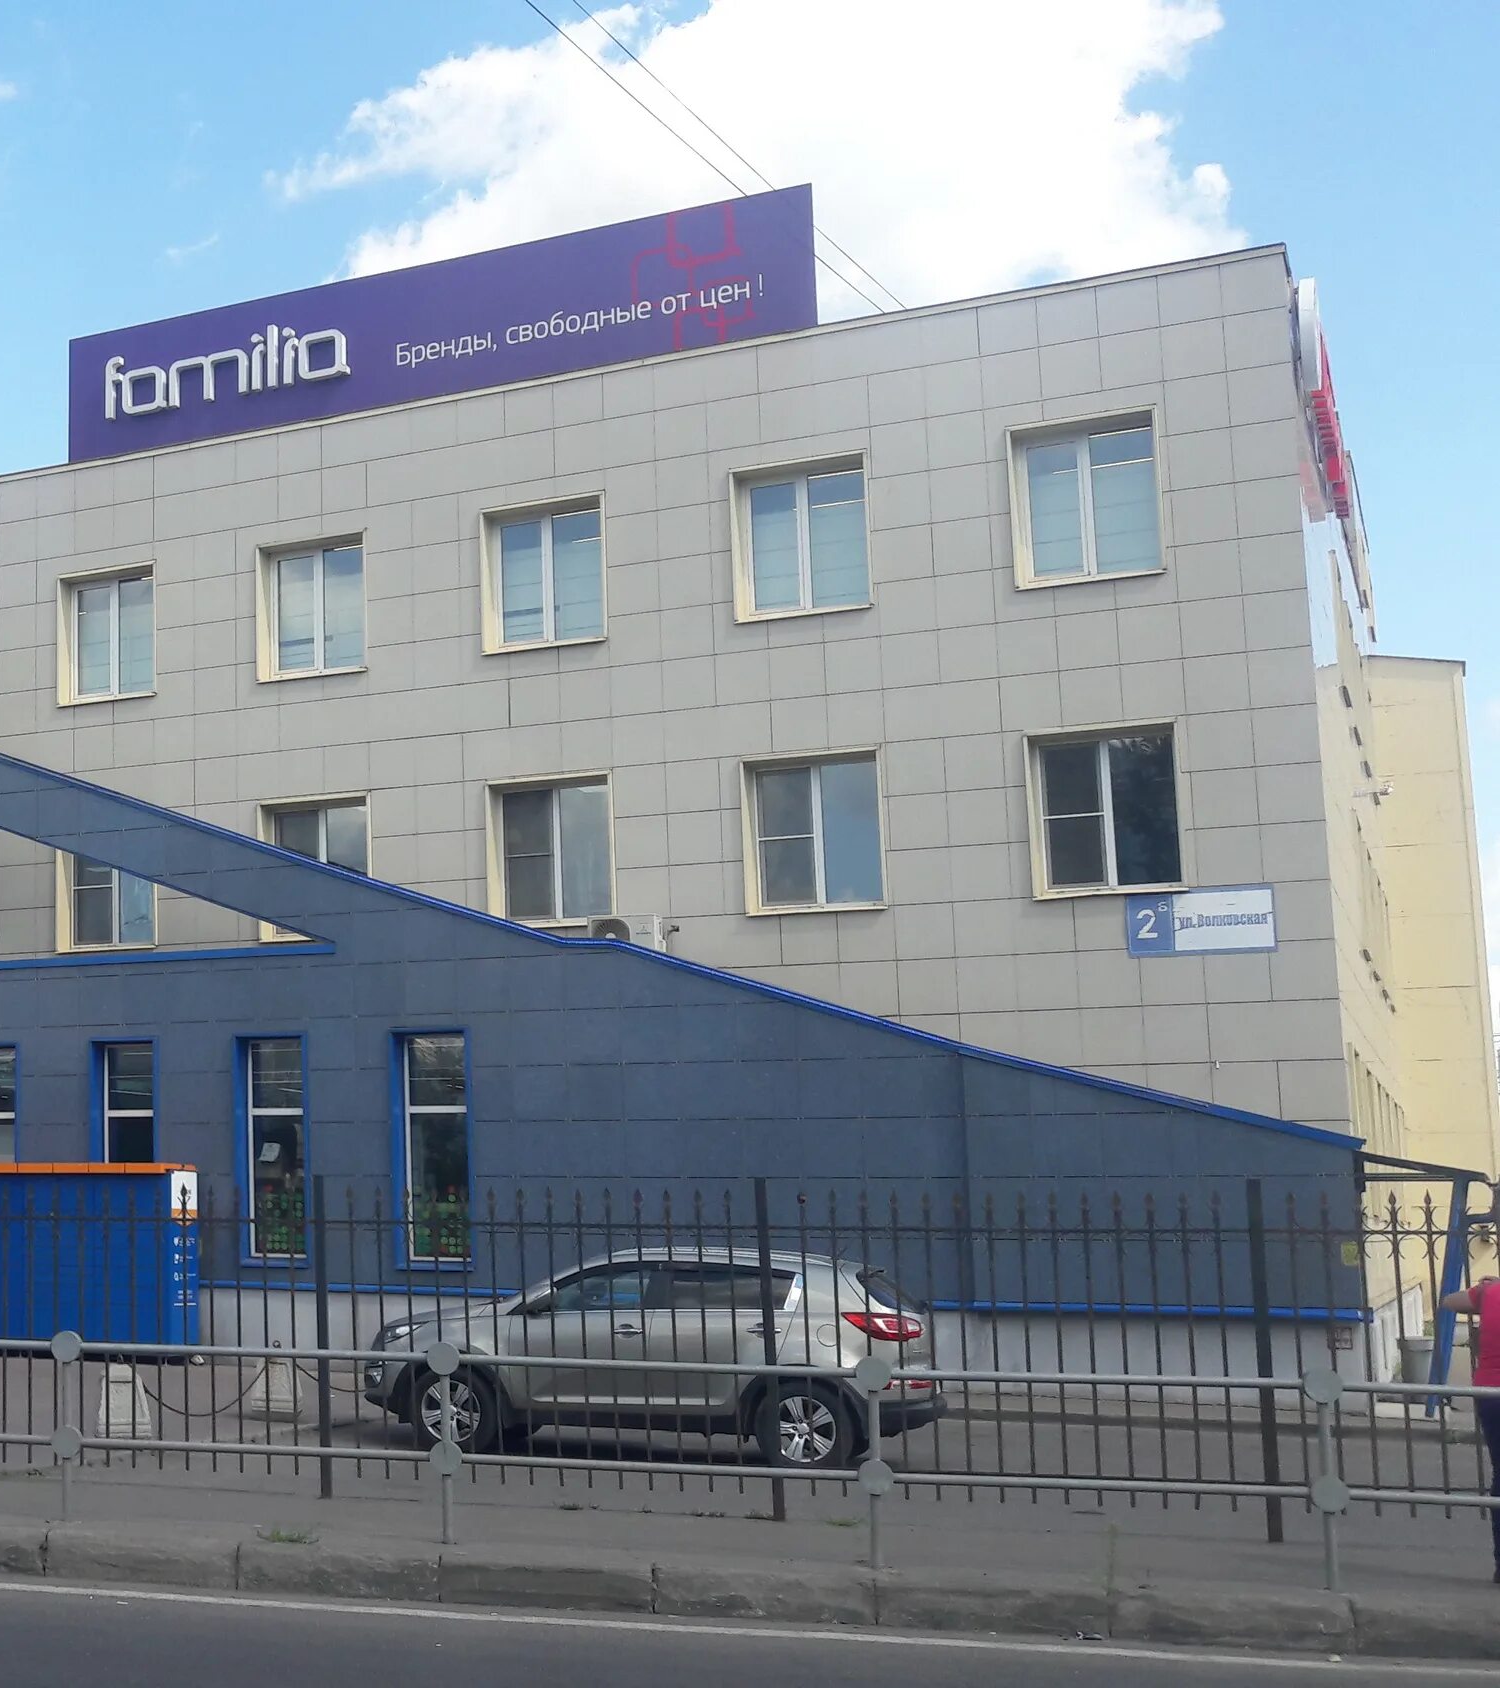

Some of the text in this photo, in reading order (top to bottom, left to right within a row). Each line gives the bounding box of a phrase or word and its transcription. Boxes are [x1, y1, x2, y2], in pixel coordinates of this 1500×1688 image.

[104, 324, 351, 421] familia
[395, 330, 498, 369] Бренды,
[505, 299, 652, 345] свободные
[660, 290, 693, 316] от
